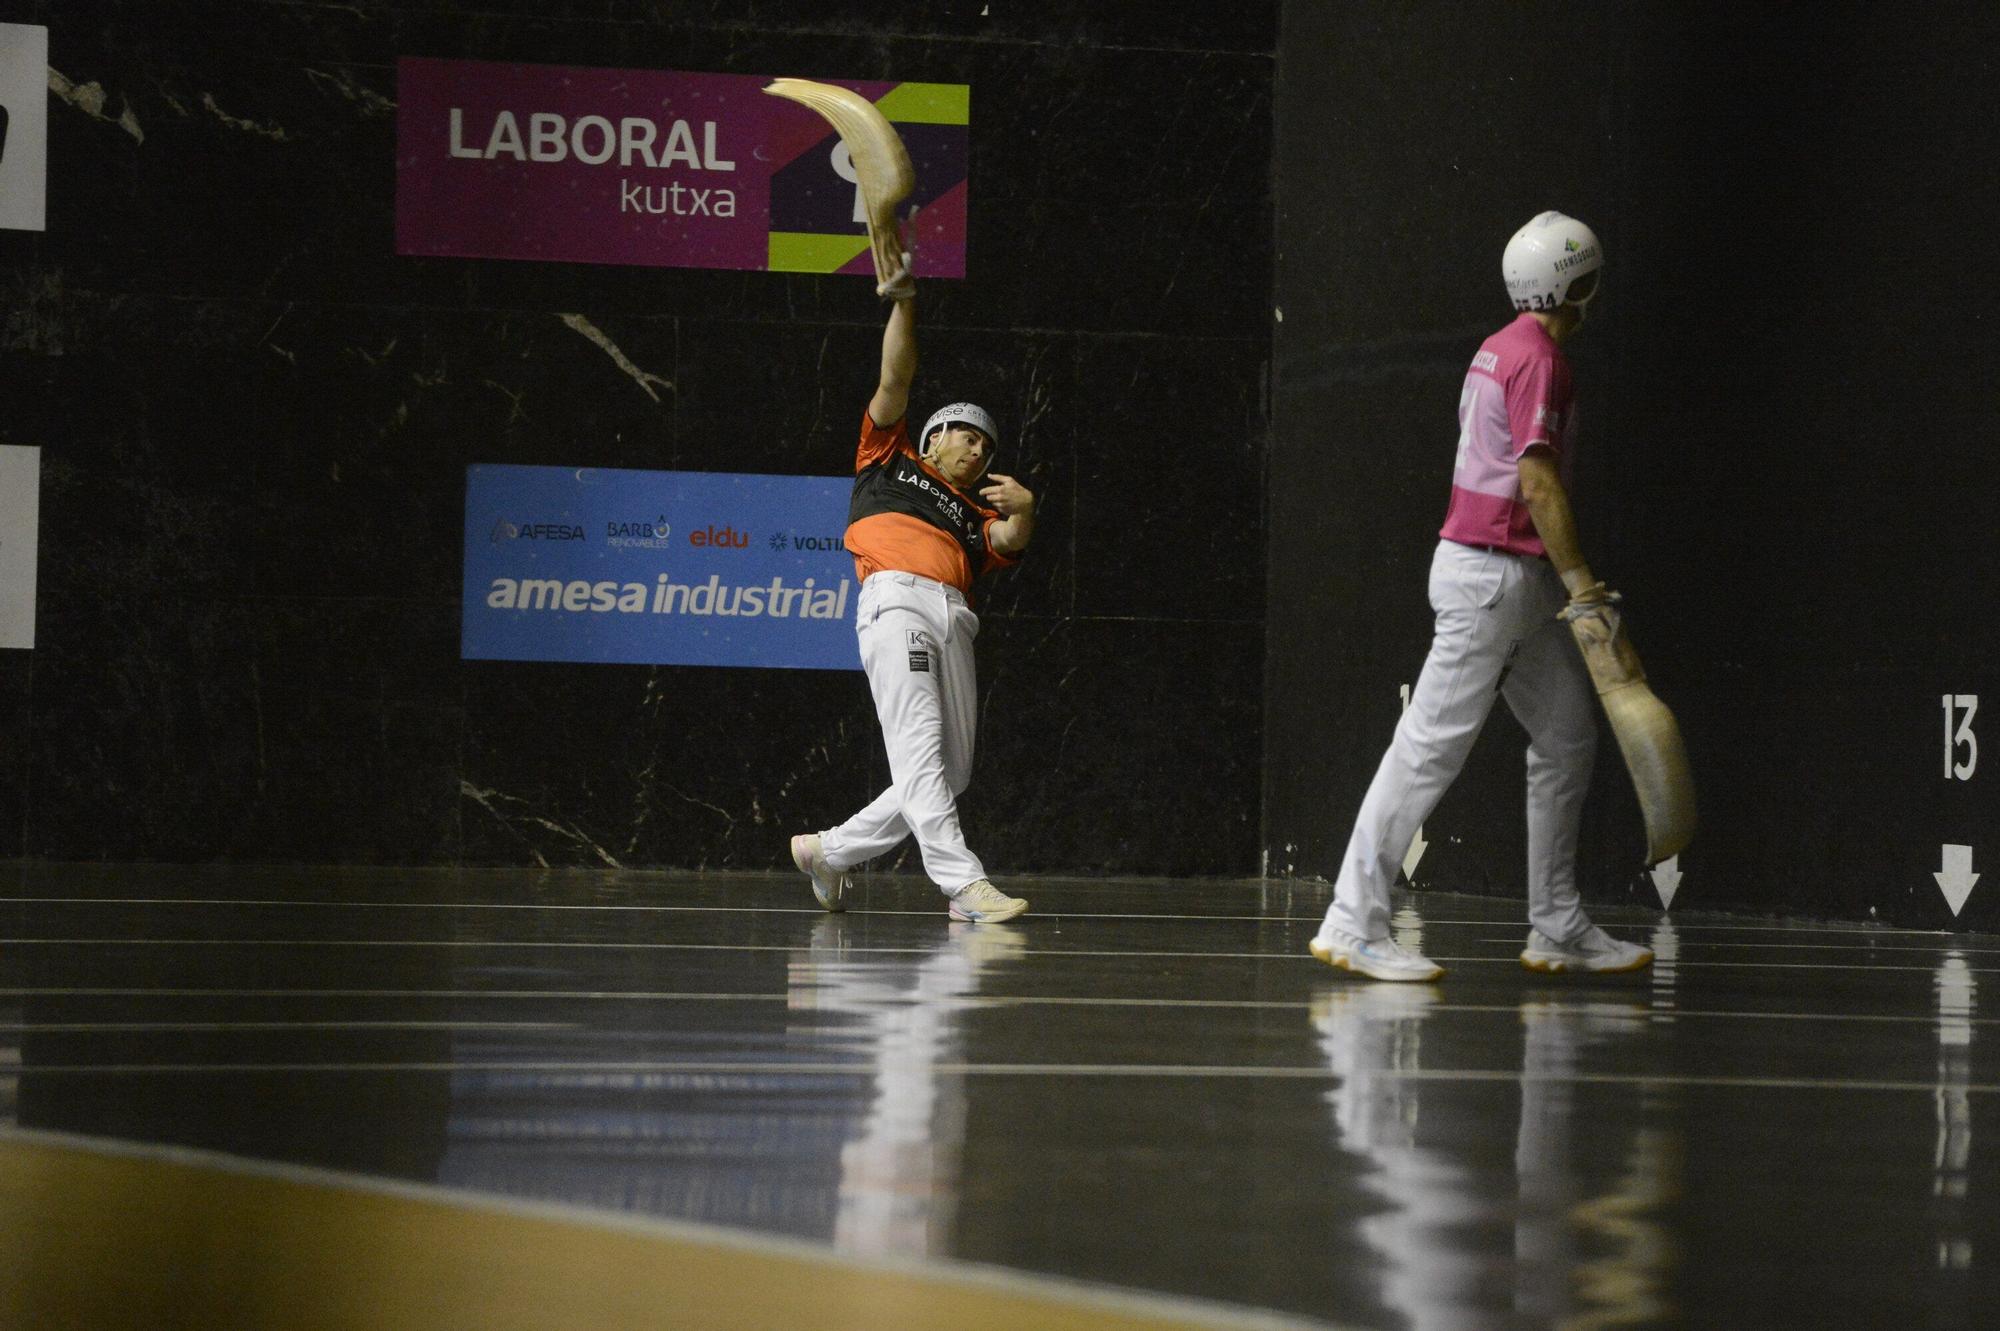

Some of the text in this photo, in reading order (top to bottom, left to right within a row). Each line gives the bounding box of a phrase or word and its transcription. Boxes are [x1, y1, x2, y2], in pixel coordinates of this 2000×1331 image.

[450, 108, 736, 172] LABORAL
[620, 178, 736, 218] kutxa
[897, 470, 963, 519] LABORAL
[520, 523, 586, 541] AFESA
[689, 525, 749, 549] eldu
[1942, 694, 1979, 781] 13
